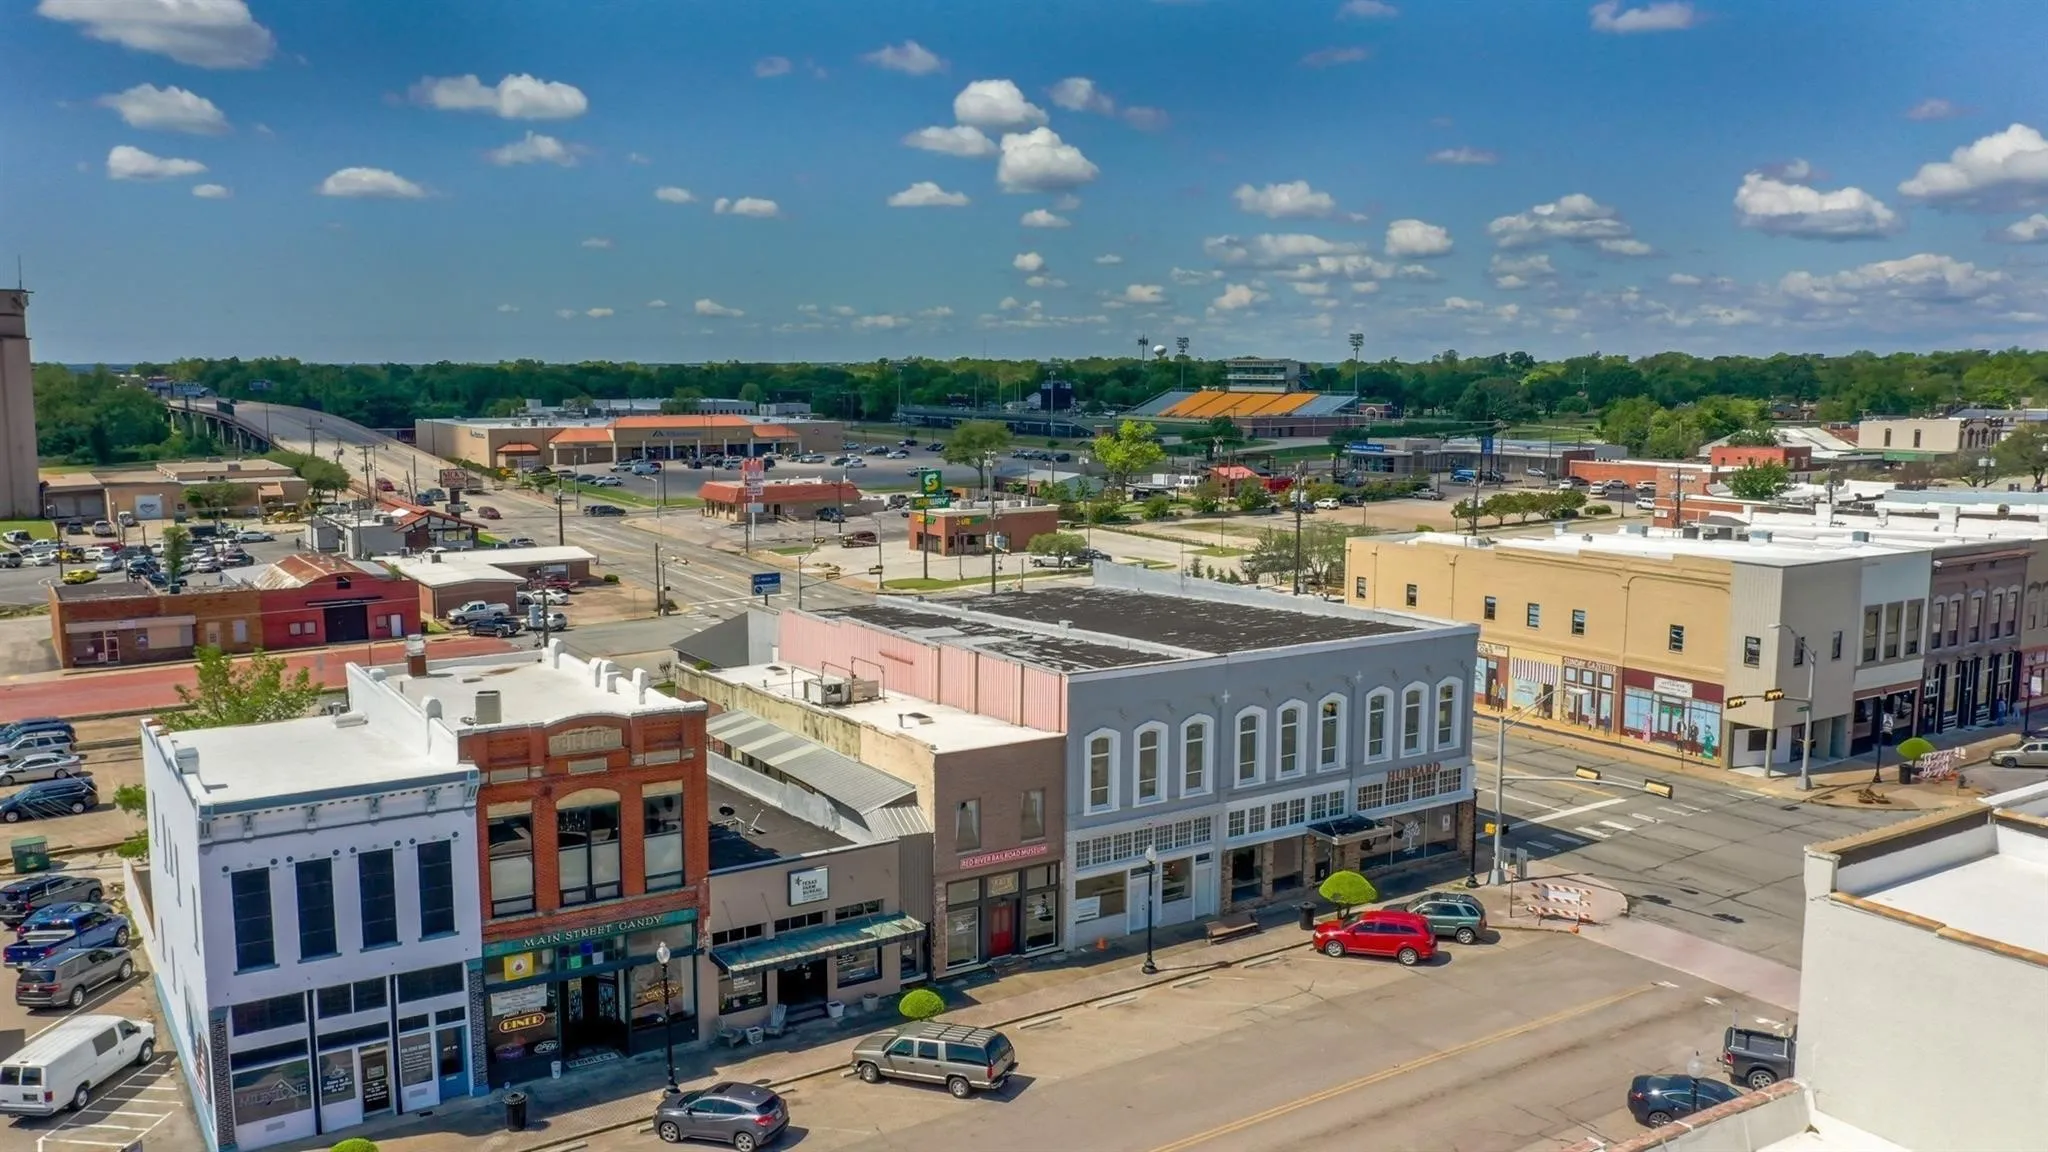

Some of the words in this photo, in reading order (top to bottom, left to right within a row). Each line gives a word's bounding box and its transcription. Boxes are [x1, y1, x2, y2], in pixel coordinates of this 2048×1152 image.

[915, 497, 949, 505] SUBWAY
[1564, 656, 1586, 667] SUNDAY
[1386, 762, 1441, 782] HUBBARD
[975, 856, 991, 865] RIVER
[991, 849, 1021, 862] RAILROAD
[1021, 845, 1047, 856] MUSEUM
[802, 887, 823, 895] BUREAU
[523, 933, 560, 948] MAIN
[565, 924, 612, 940] STREET
[618, 915, 663, 931] CANDY
[503, 1016, 542, 1030] DINER
[537, 1042, 557, 1052] OPEN
